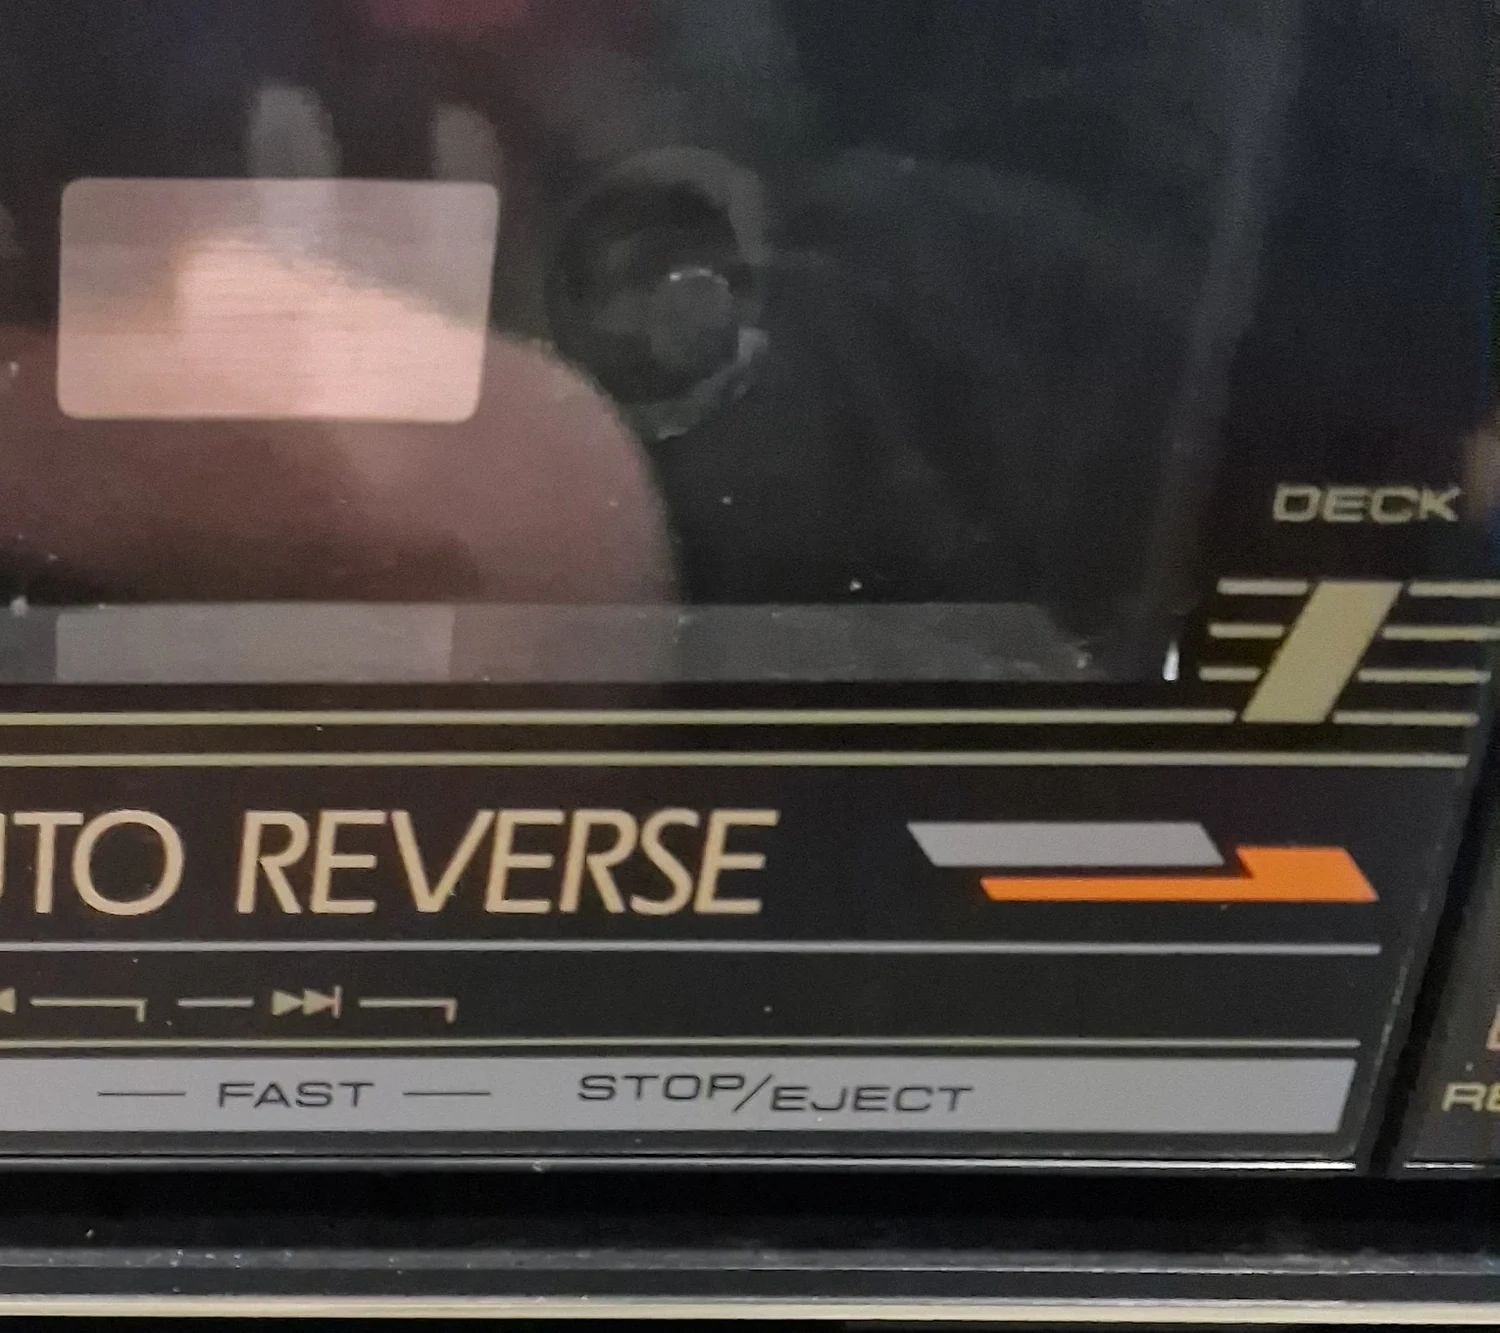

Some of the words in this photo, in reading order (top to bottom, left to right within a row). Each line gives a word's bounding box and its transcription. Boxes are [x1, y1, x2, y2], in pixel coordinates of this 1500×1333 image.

[1272, 483, 1461, 524] DECK
[236, 810, 779, 915] REVERSE
[218, 1082, 375, 1109] FAST
[577, 1072, 974, 1114] STOP/EJECT
